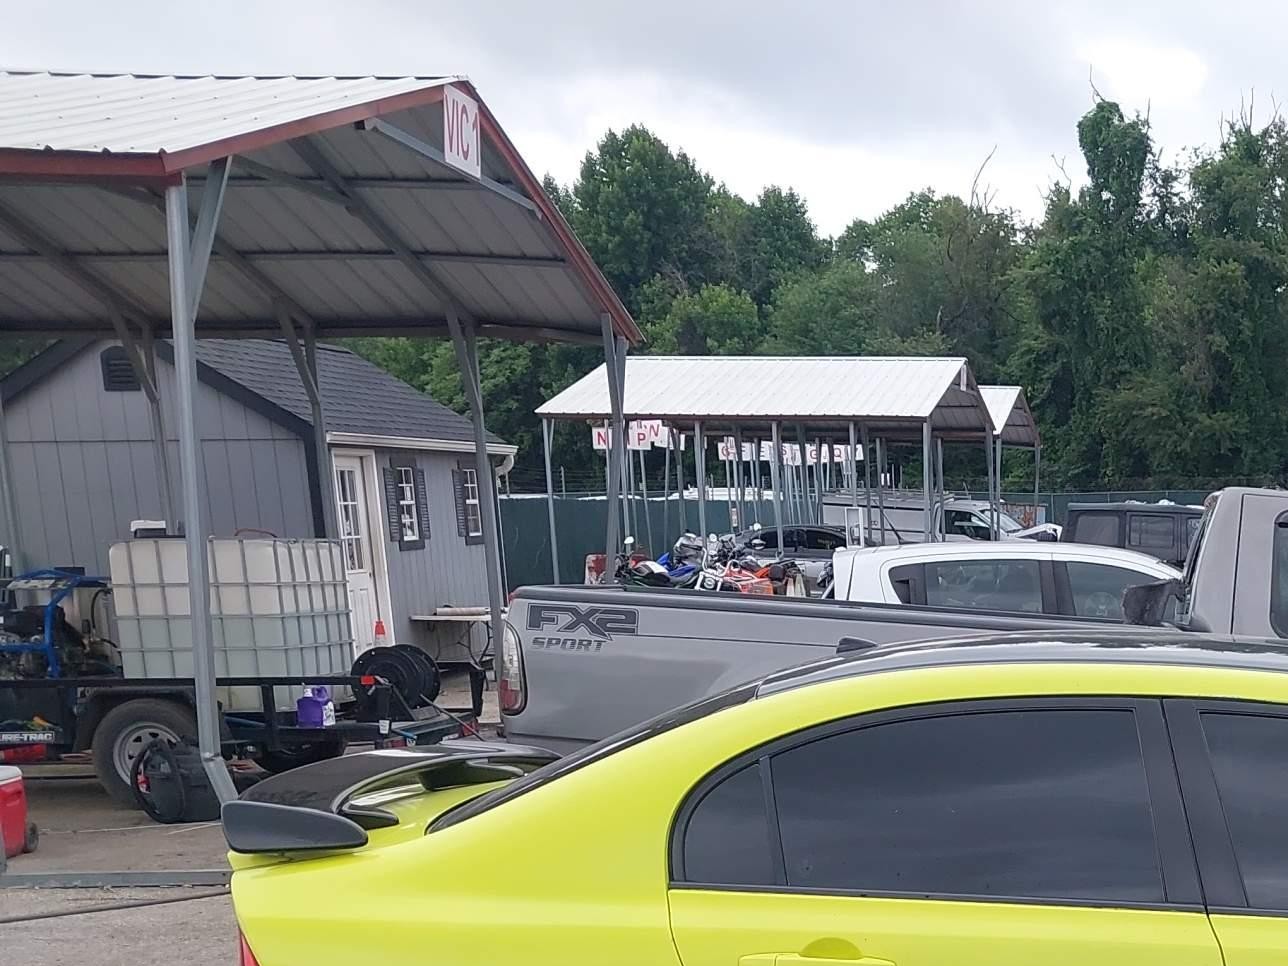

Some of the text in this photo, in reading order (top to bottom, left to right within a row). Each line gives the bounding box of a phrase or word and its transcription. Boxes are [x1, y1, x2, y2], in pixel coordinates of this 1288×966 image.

[445, 94, 480, 166] VIC 1
[526, 603, 640, 641] FX2
[532, 637, 608, 652] SPORT
